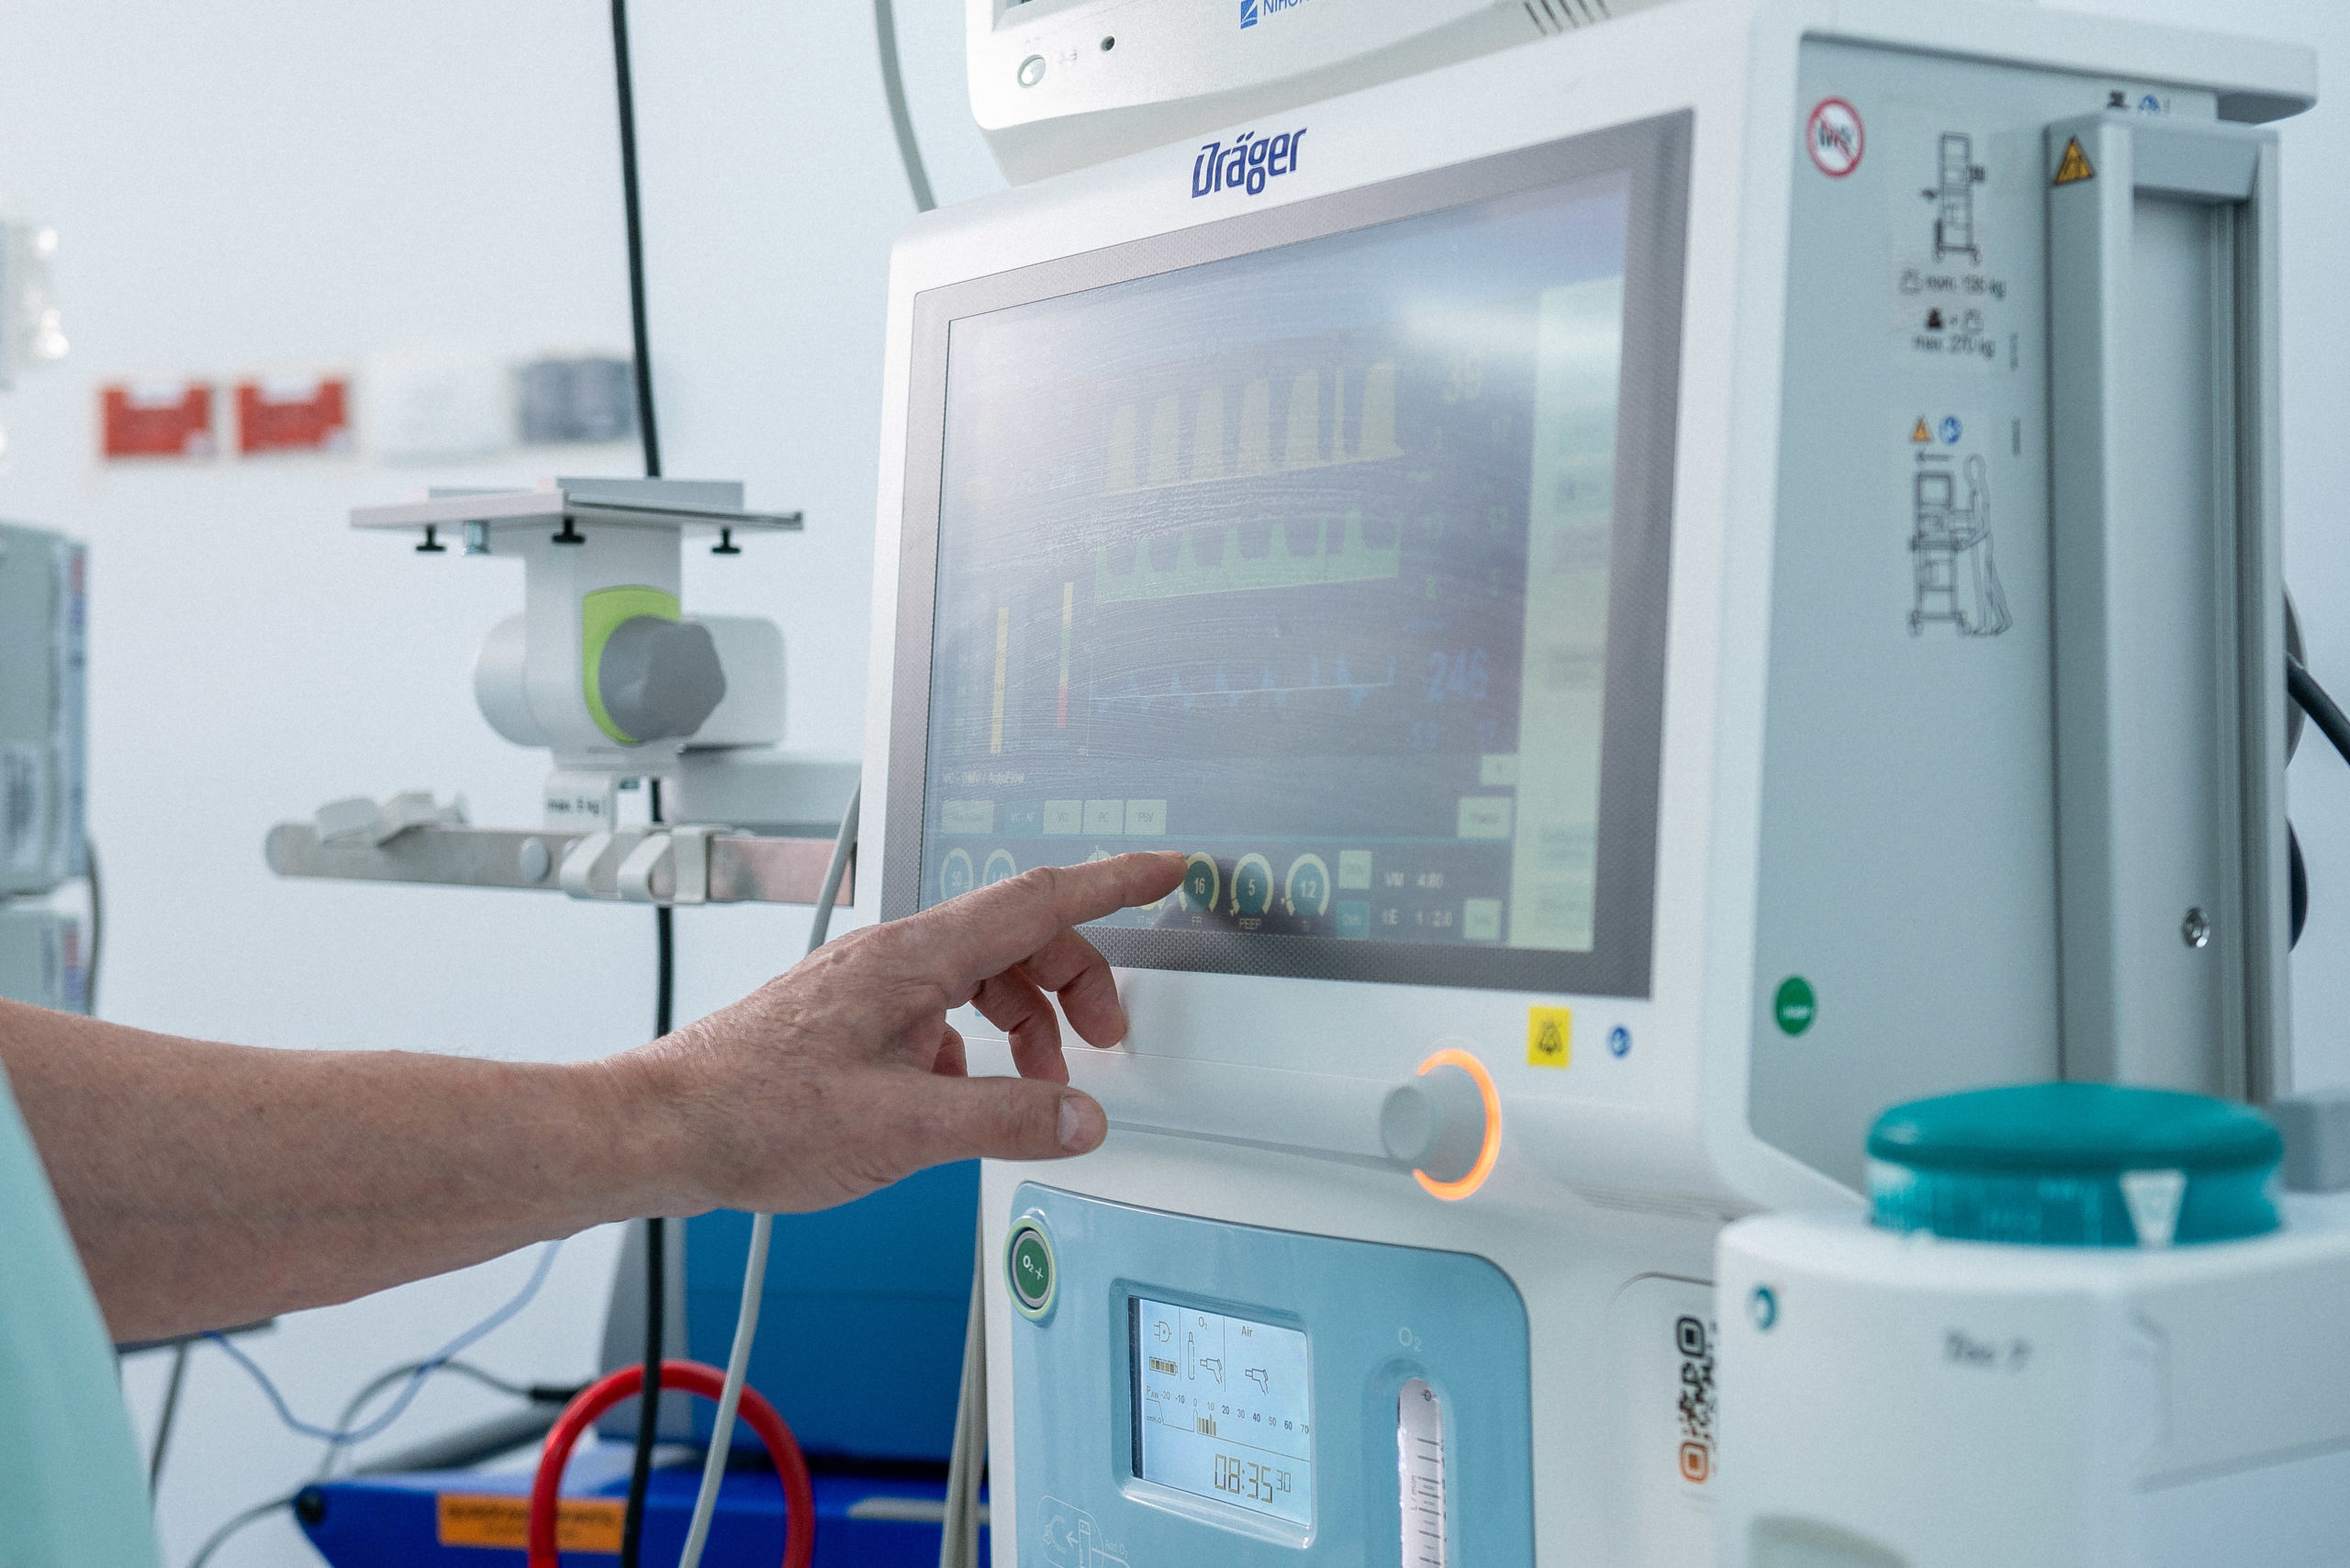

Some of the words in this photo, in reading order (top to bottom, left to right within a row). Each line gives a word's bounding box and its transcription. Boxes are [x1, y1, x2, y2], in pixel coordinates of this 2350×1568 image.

[1192, 127, 1307, 198] Dräger
[1427, 648, 1489, 701] 246
[1138, 812, 1154, 823] PSV
[1193, 878, 1205, 894] 16
[1248, 879, 1256, 896] 5
[1300, 880, 1316, 899] 1.2
[1192, 915, 1203, 926] FR
[1239, 918, 1261, 929] PEEP
[1198, 1316, 1208, 1329] O2
[1241, 1326, 1253, 1338] Air
[1399, 1327, 1422, 1352] O2
[1160, 1390, 1170, 1401] -20
[1175, 1394, 1185, 1404] -10
[1192, 1397, 1197, 1407] 0
[1207, 1402, 1214, 1411] 10
[1222, 1405, 1230, 1416] 20
[1237, 1408, 1246, 1419] 30
[1252, 1413, 1261, 1423] 40
[1269, 1417, 1277, 1427] 50
[1284, 1420, 1293, 1430] 60
[1301, 1424, 1310, 1434] 70
[1214, 1453, 1273, 1504] 08:35
[1276, 1469, 1292, 1494] 30
